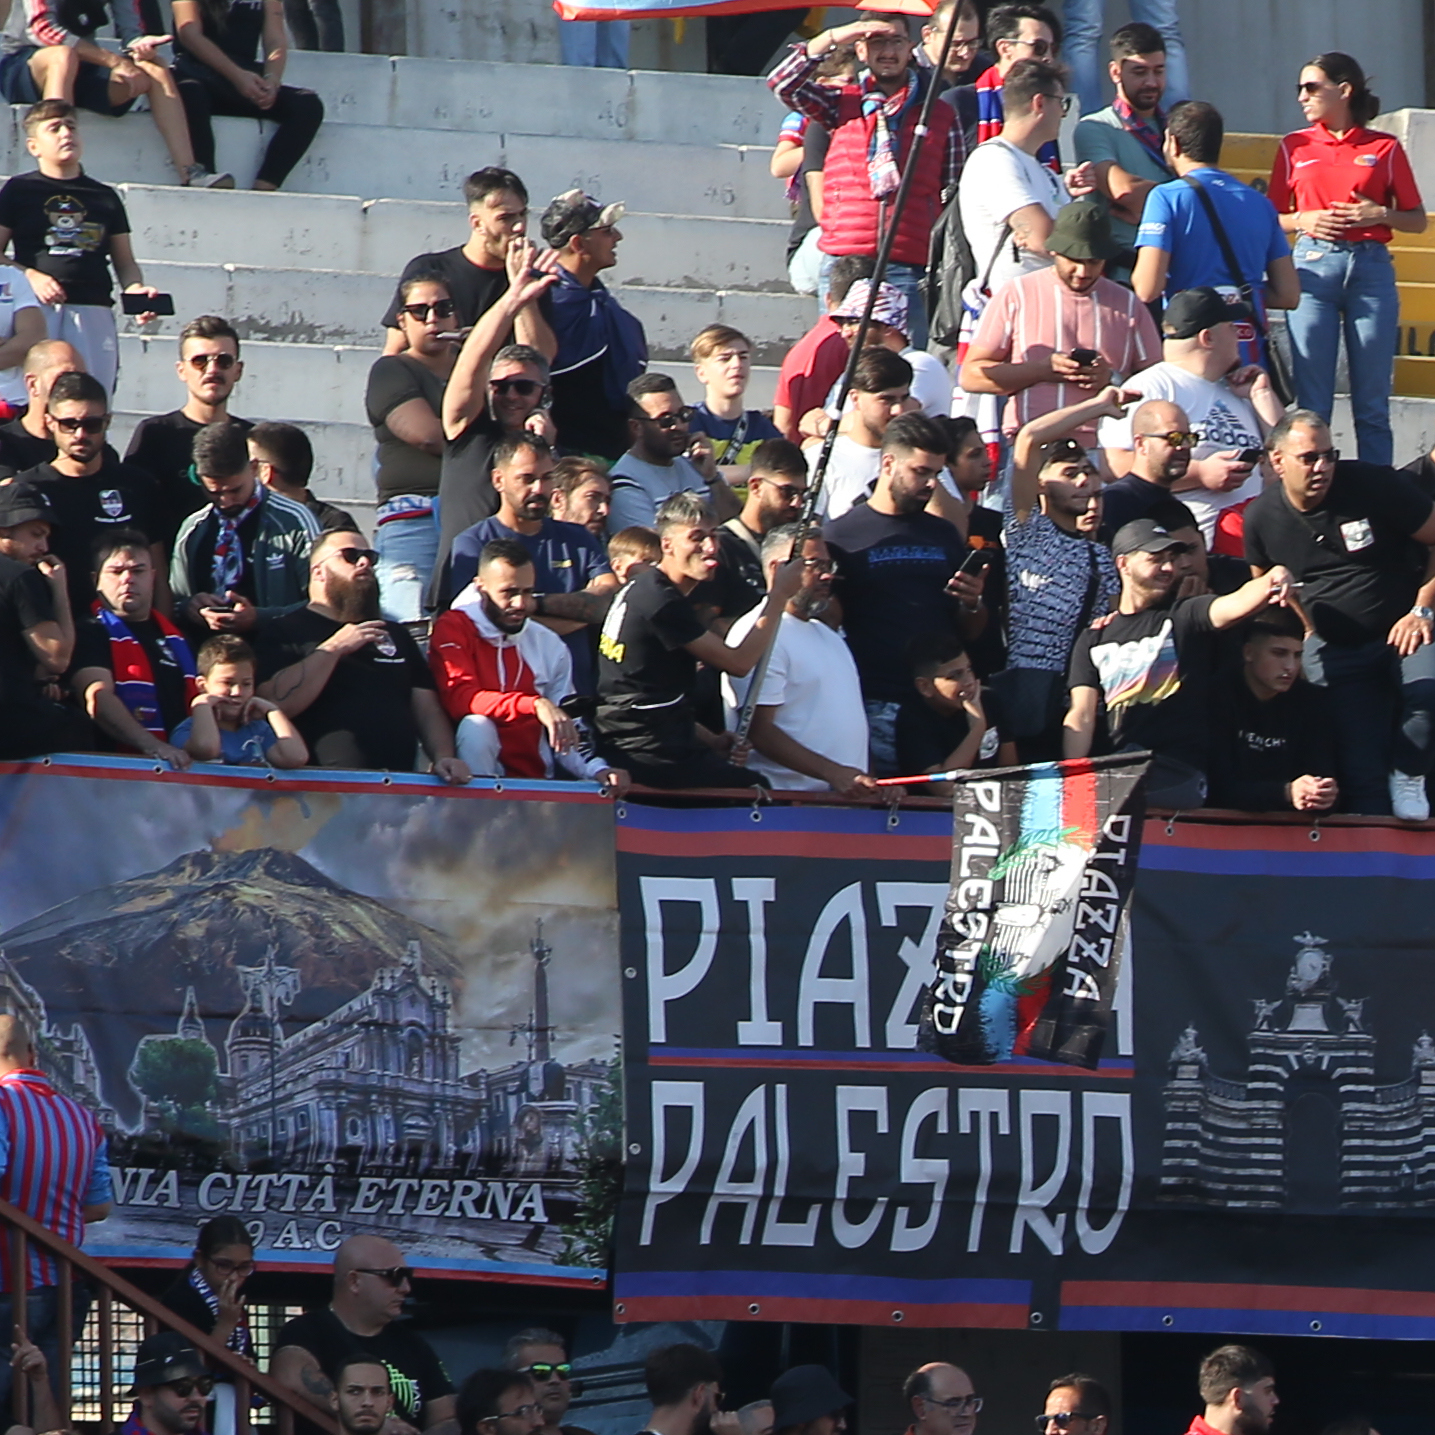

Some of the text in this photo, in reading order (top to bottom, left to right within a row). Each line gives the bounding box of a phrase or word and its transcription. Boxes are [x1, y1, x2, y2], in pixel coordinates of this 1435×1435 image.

[932, 779, 1003, 1038] PALESTRO
[1062, 813, 1132, 1003] PIAZZA
[197, 1158, 338, 1214] CITTÀ
[349, 1176, 550, 1225] ETERNA
[638, 1081, 1135, 1256] PALESTRO
